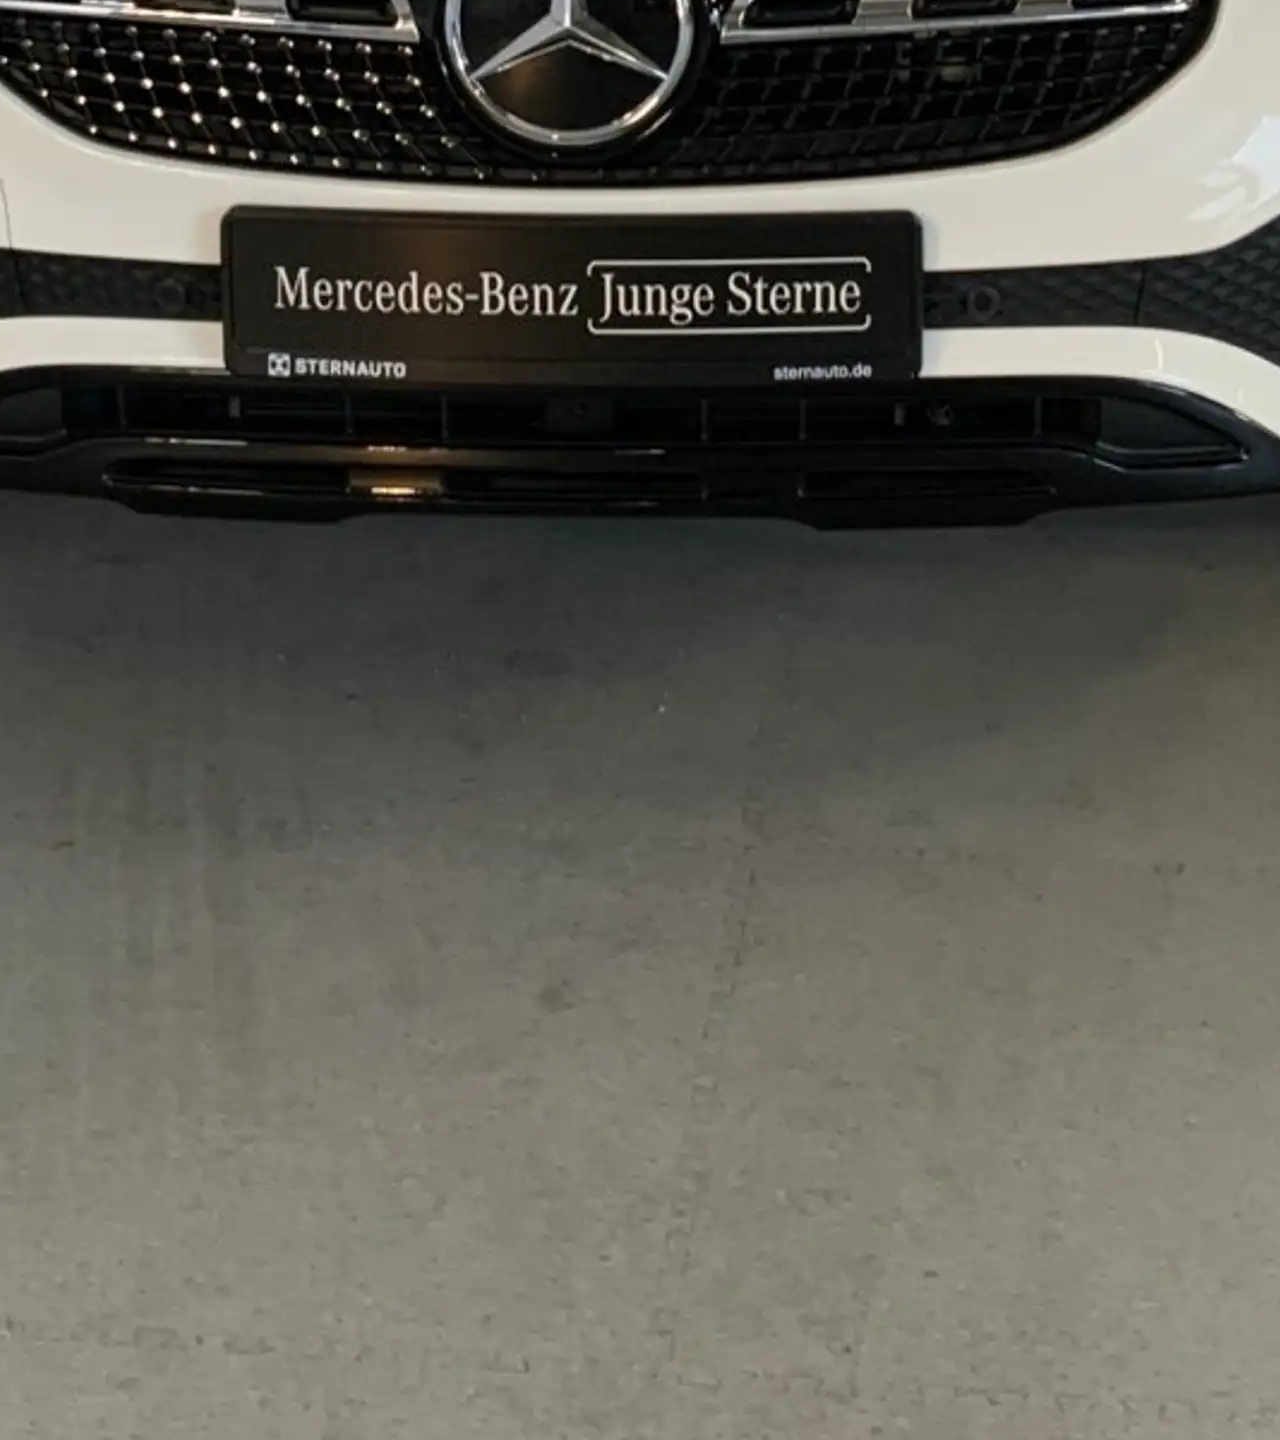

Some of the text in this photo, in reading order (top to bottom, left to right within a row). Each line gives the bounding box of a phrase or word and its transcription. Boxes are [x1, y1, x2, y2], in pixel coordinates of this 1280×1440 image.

[274, 265, 861, 326] Mercedes-Benz Junge Sterne
[294, 357, 407, 379] STERNAUTO
[773, 362, 873, 381] sternauto.de
